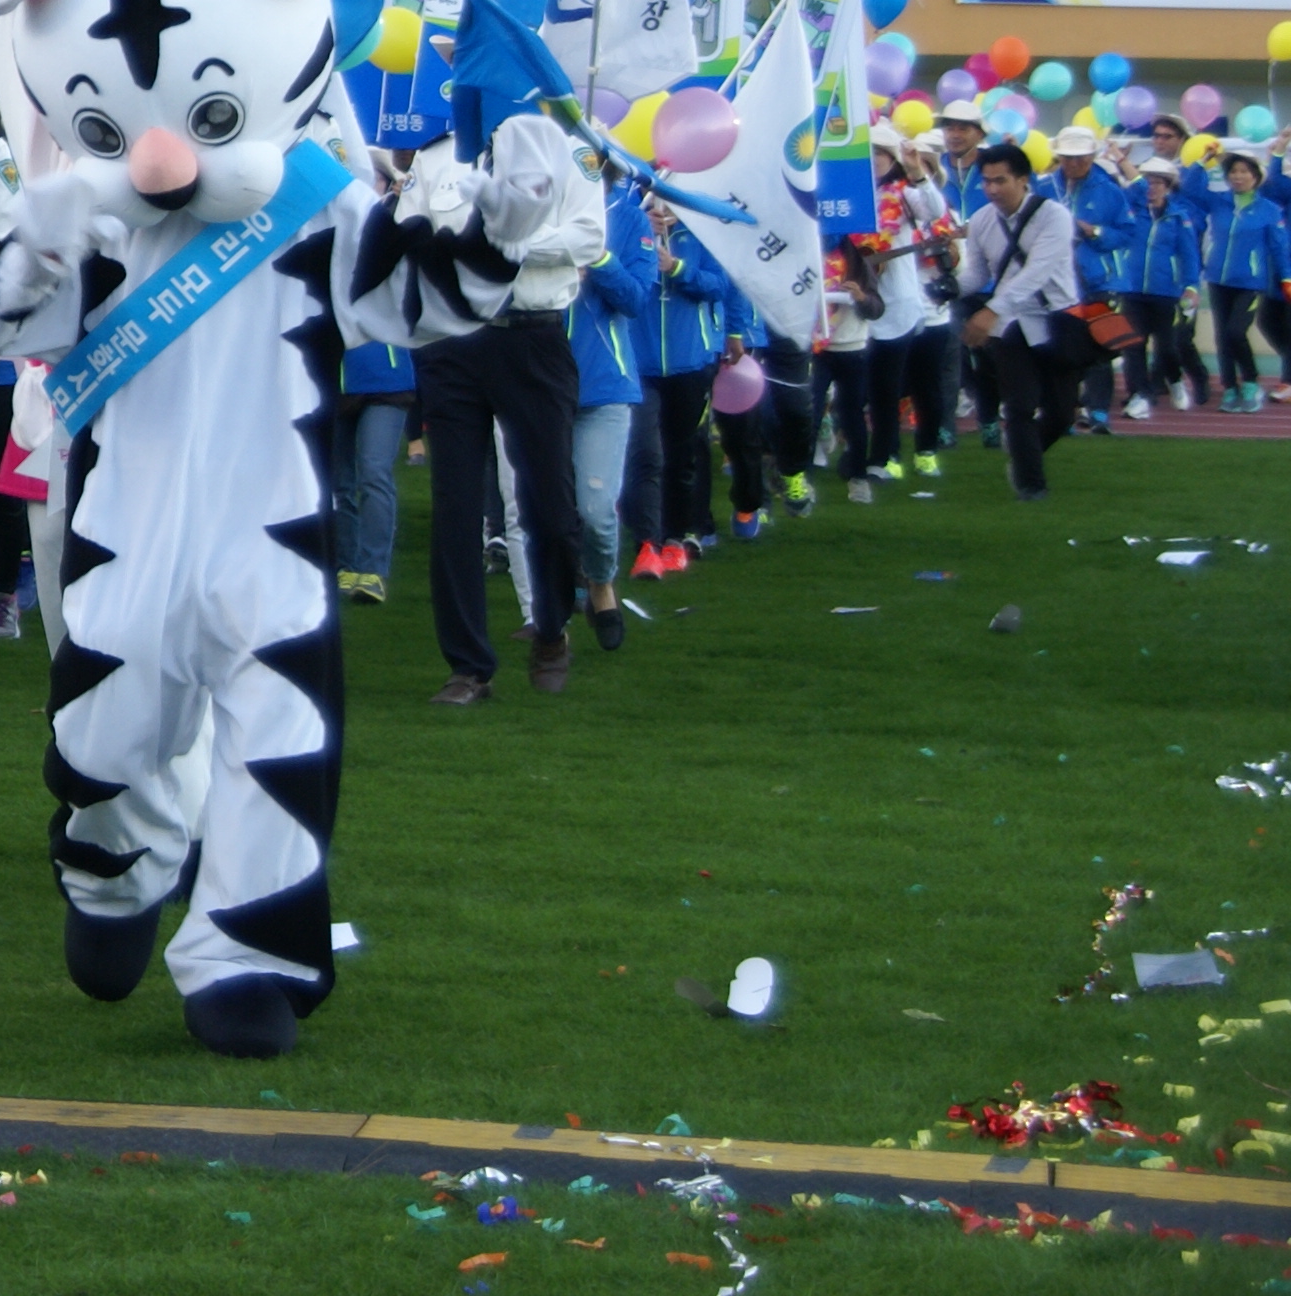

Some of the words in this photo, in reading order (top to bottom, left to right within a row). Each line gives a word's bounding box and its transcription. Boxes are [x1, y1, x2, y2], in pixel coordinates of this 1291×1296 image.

[640, 0, 670, 32] 장
[817, 199, 851, 218] 평동
[210, 209, 273, 274] 우리
[147, 263, 213, 326] 모두
